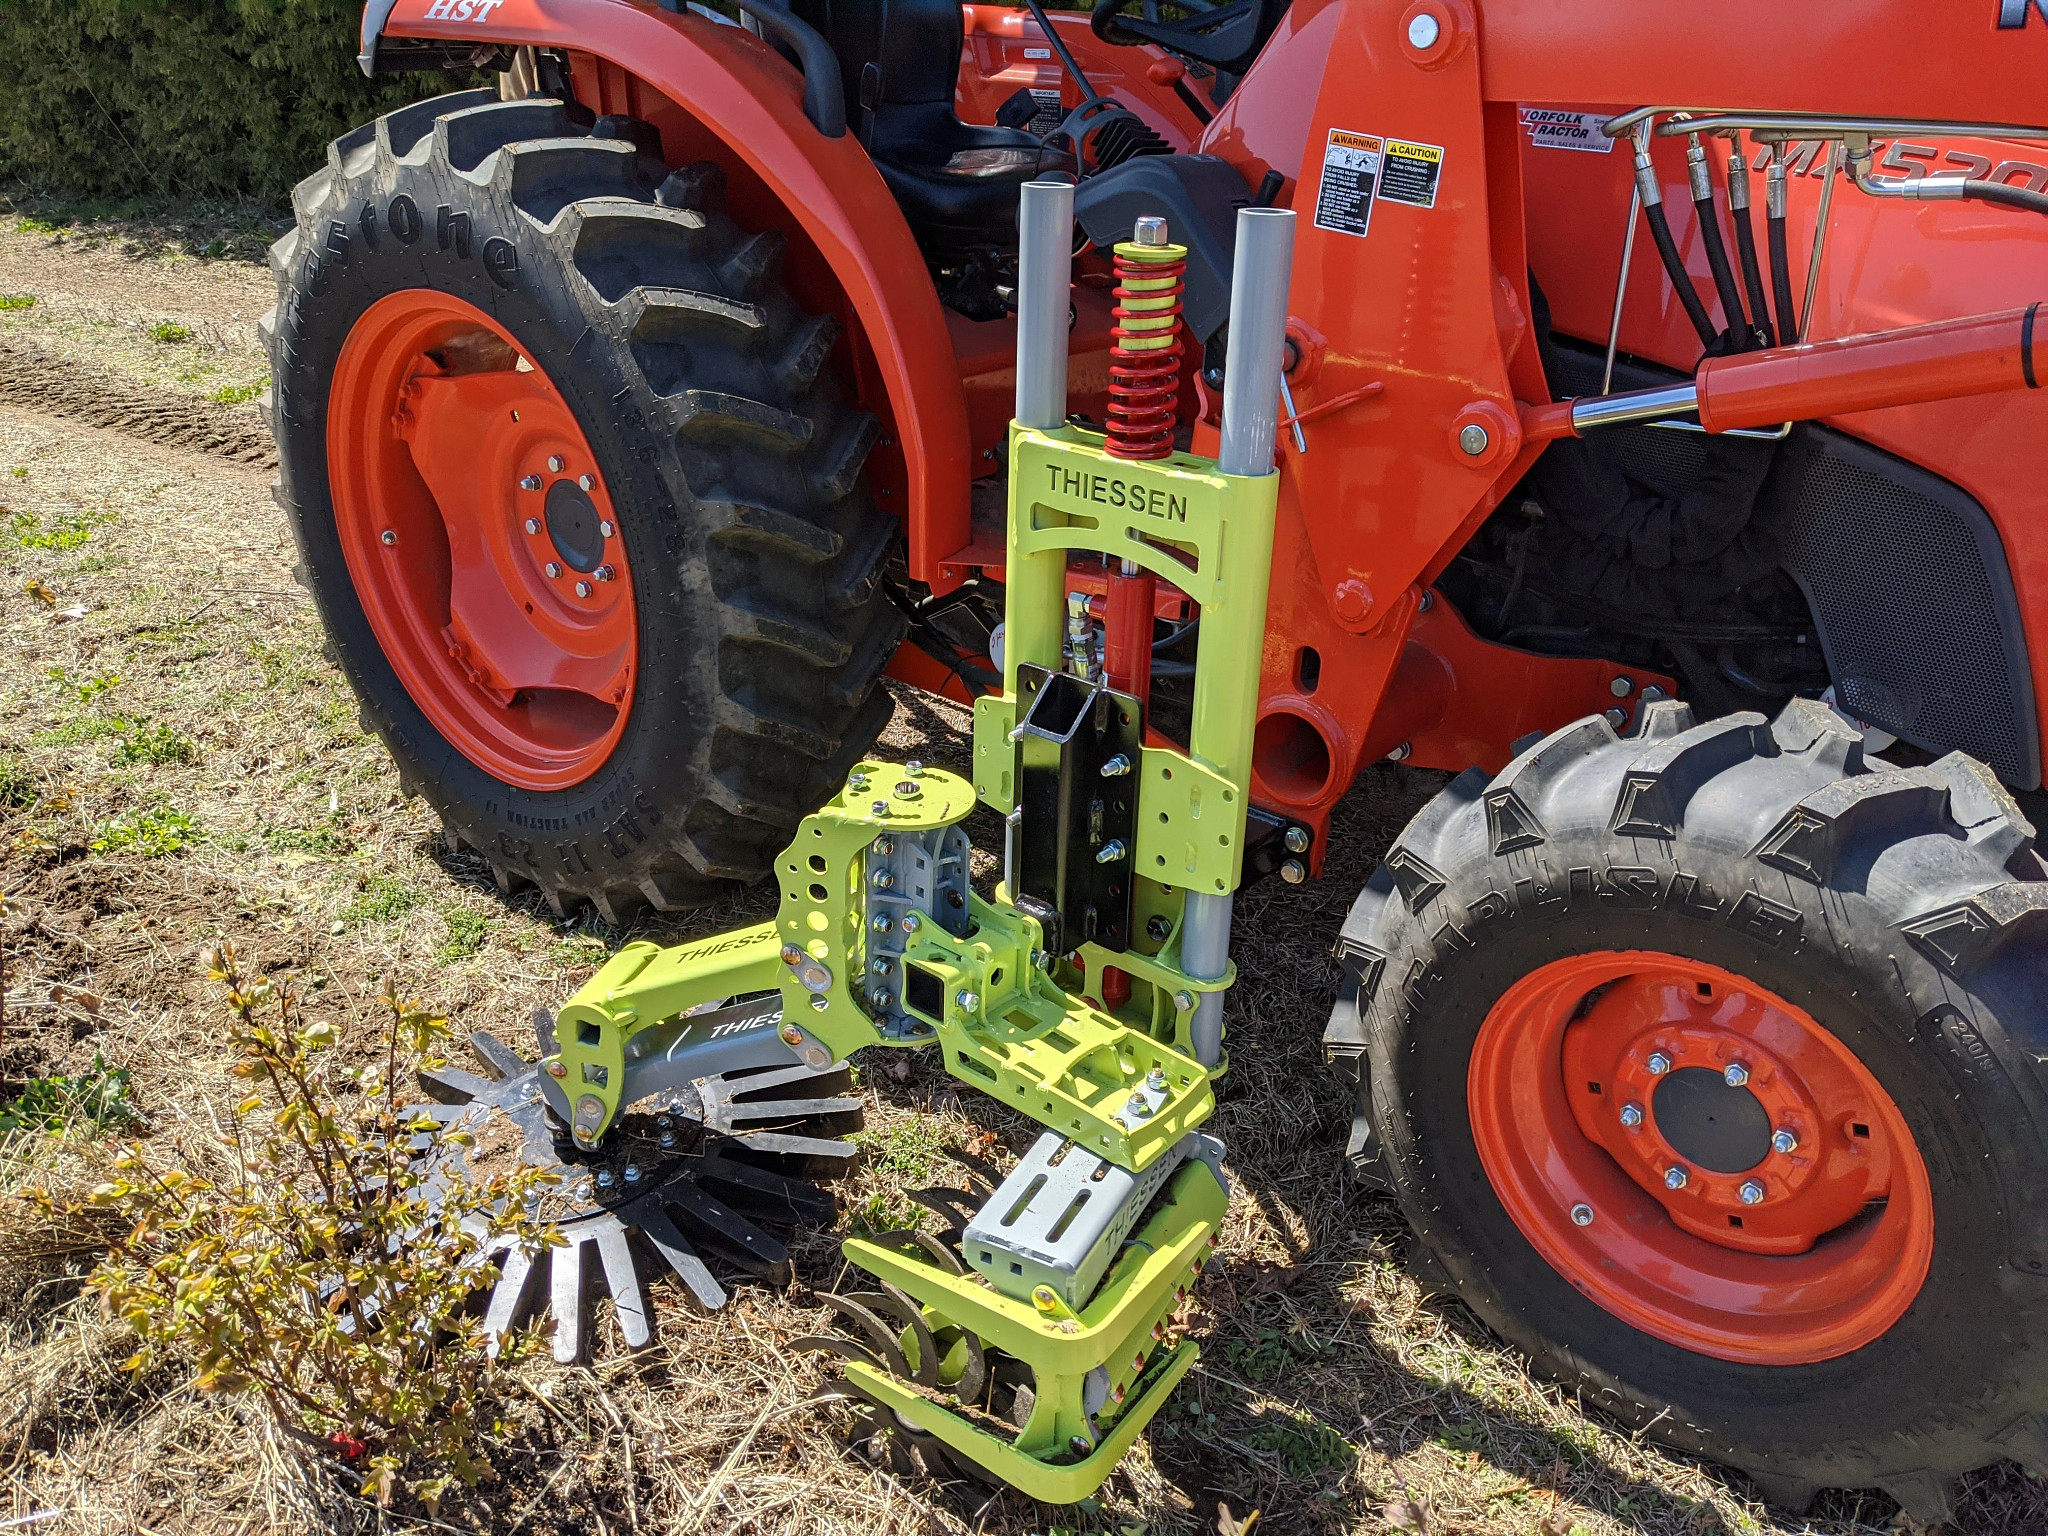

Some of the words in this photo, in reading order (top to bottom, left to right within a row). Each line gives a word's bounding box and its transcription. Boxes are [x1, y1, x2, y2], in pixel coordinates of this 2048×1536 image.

[424, 0, 503, 24] HST
[1527, 122, 1589, 138] TRACTOR
[1341, 135, 1378, 150] WARNING
[1399, 146, 1437, 159] CAUTION
[1045, 464, 1188, 524] THIESSEN
